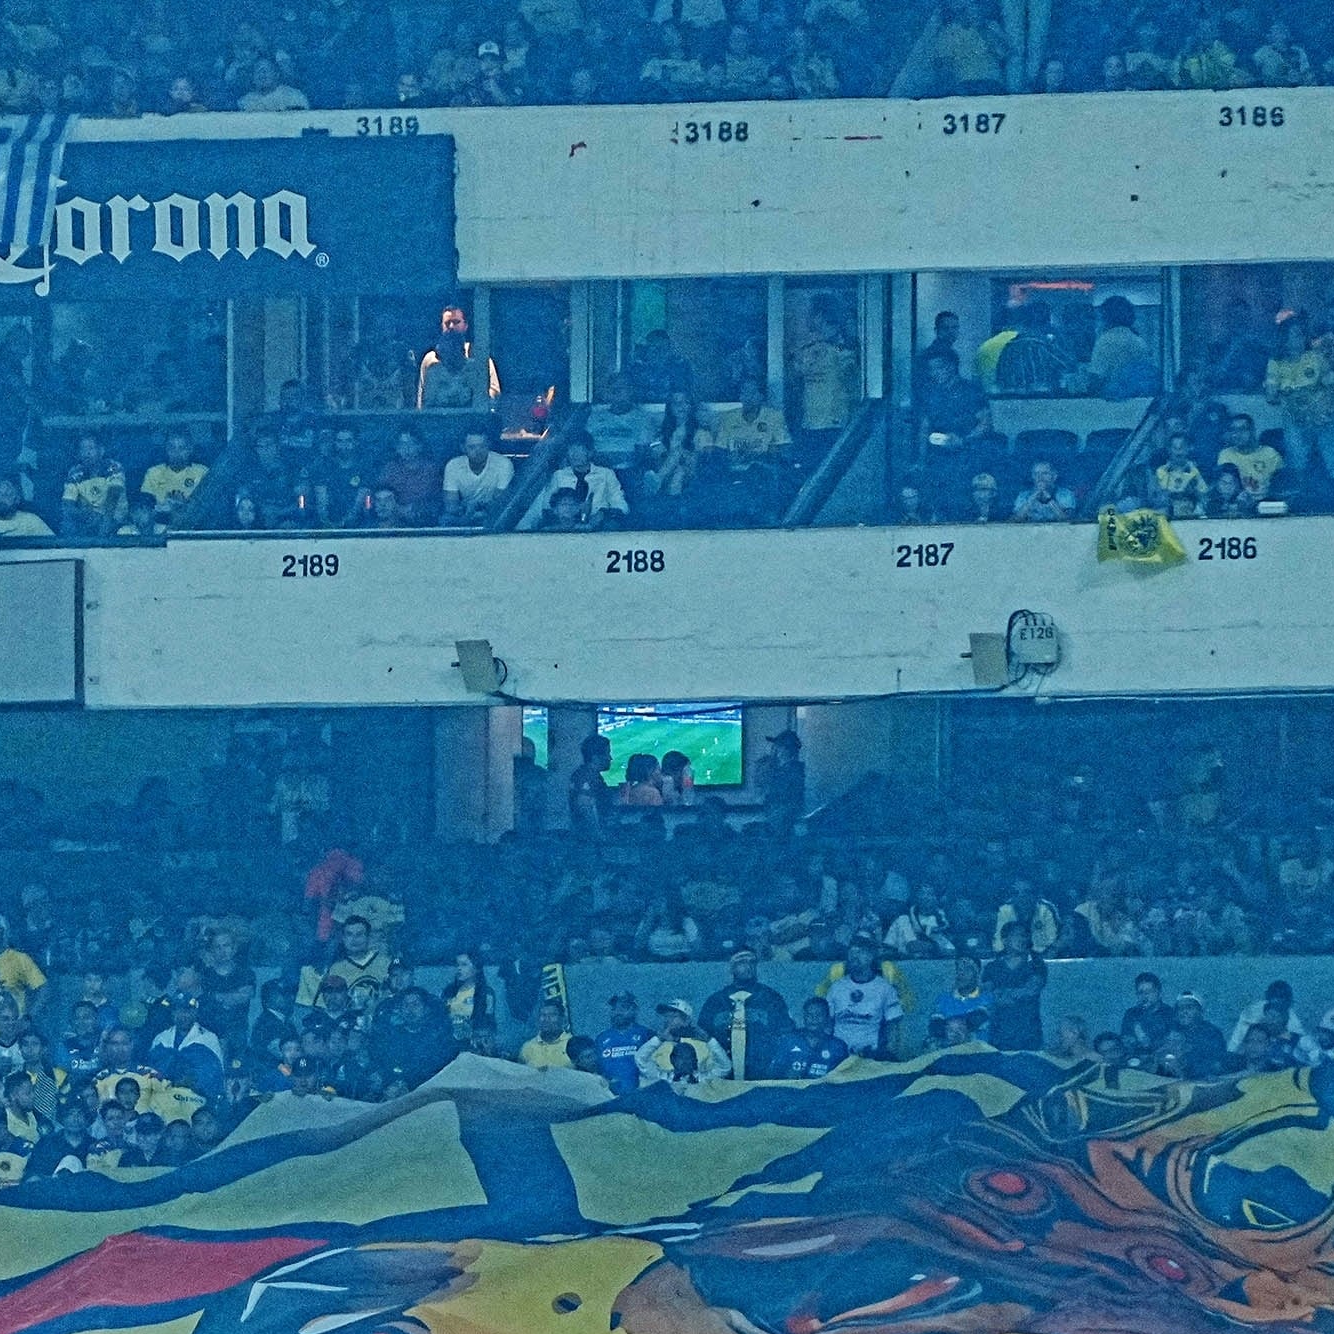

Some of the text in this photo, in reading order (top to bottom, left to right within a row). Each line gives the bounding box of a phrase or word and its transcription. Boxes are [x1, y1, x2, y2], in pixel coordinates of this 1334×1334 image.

[356, 116, 420, 136] 3189
[943, 113, 1005, 135] 3187
[1219, 107, 1284, 127] 3186
[686, 122, 748, 144] 3188
[897, 543, 954, 567] 2187
[1198, 537, 1257, 560] 2186
[282, 554, 338, 577] 2189
[607, 550, 665, 573] 2188
